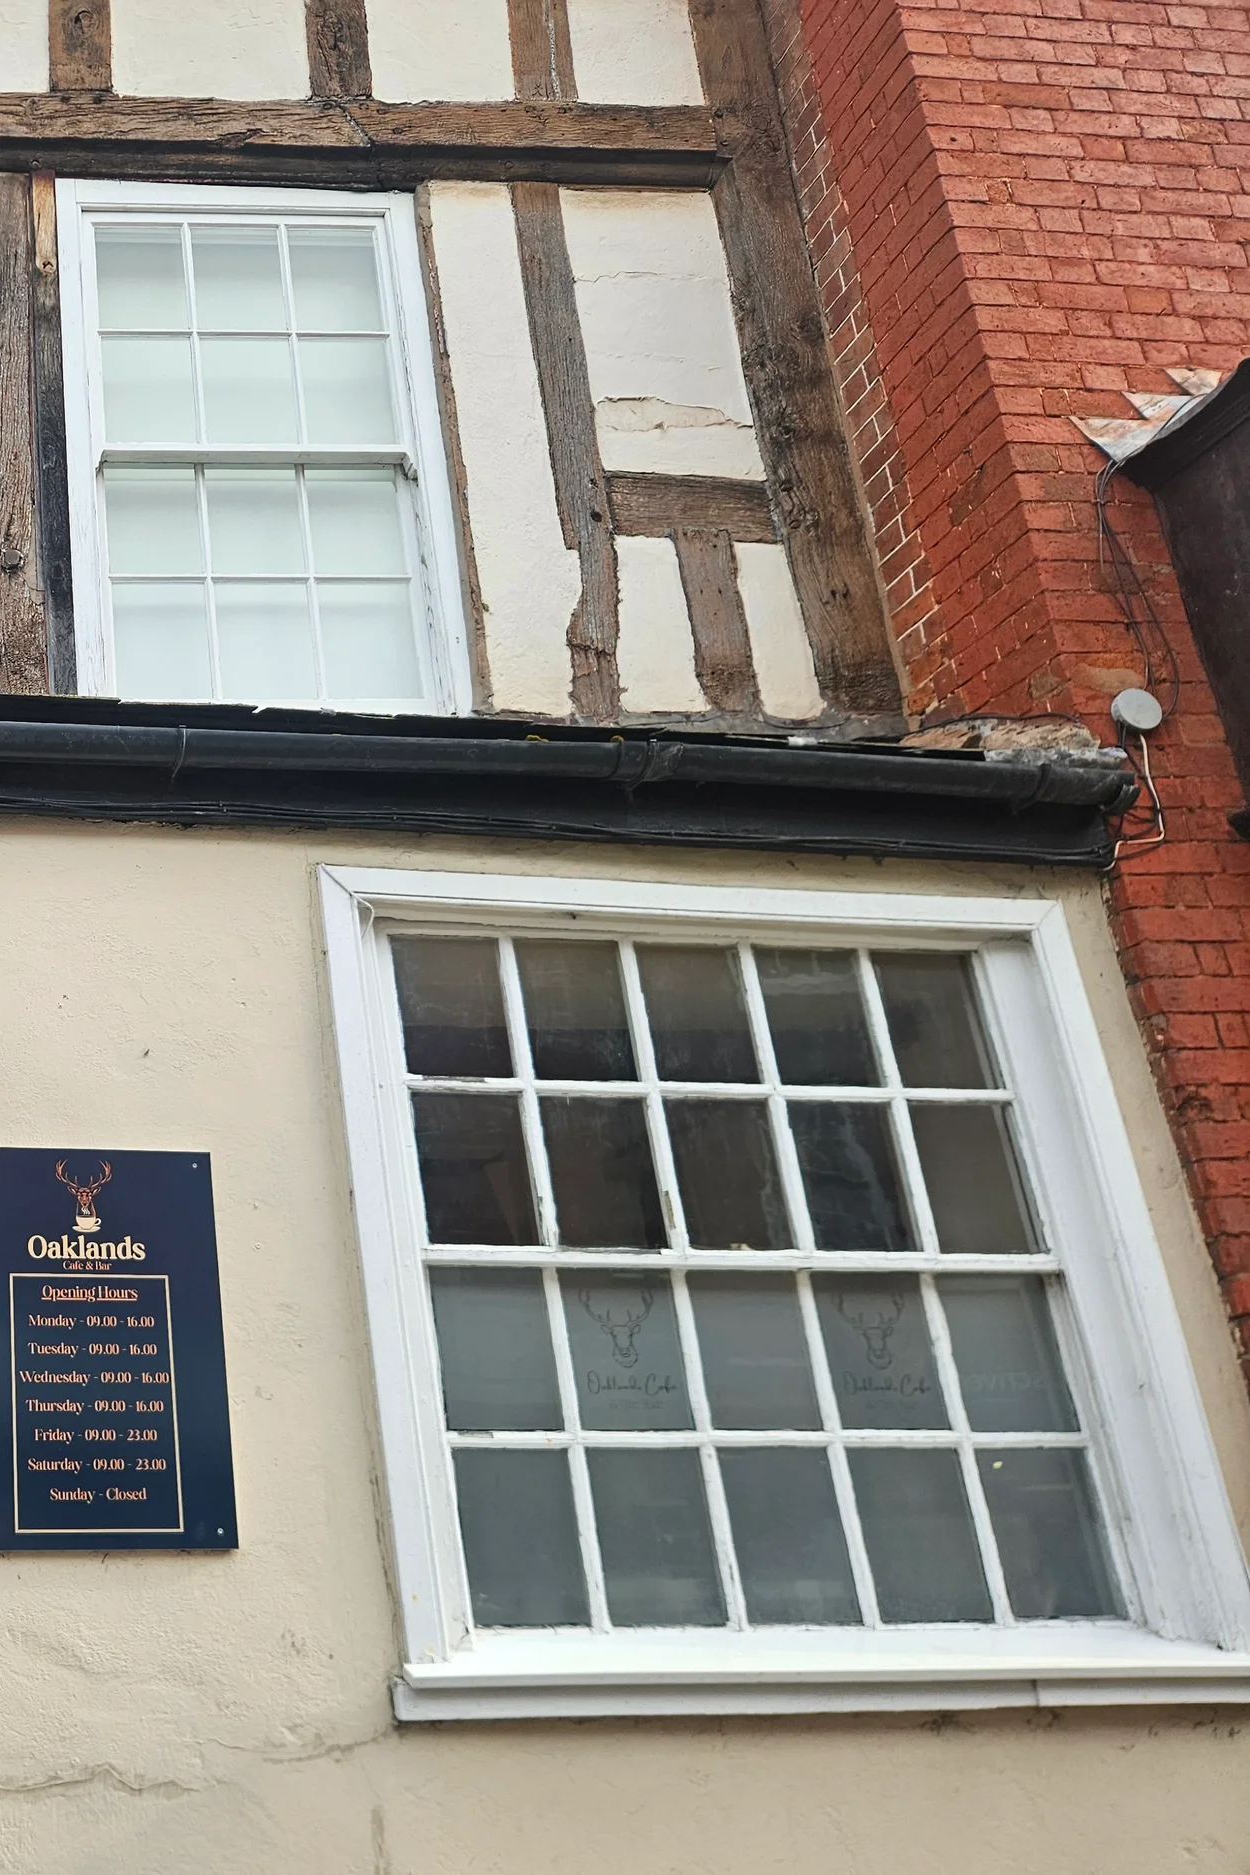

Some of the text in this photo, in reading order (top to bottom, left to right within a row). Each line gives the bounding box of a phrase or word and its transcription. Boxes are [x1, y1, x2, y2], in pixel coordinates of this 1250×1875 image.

[27, 1234, 146, 1261] Oaklands
[62, 1260, 113, 1271] Cafe & Bar
[41, 1284, 139, 1302] Opening Hours
[28, 1314, 77, 1330] Monday
[86, 1315, 118, 1327] 09.00
[126, 1316, 155, 1328] 16.00
[27, 1342, 79, 1358] Tuesday
[88, 1343, 120, 1355] 09.00
[129, 1344, 158, 1355] 16.00
[19, 1370, 91, 1387] Wednesday
[100, 1371, 132, 1384] 09.00
[141, 1371, 170, 1384] 16.00
[25, 1399, 85, 1416] Thursday
[94, 1400, 126, 1412] 09.00
[135, 1400, 164, 1412] 16.00
[34, 1428, 75, 1445] Friday
[84, 1429, 117, 1441] 09.00
[126, 1429, 158, 1441] 23.00
[27, 1457, 83, 1474] Saturday
[92, 1458, 125, 1470] 09.00
[135, 1458, 167, 1470] 23.00
[49, 1487, 96, 1504] Sunday
[105, 1487, 147, 1501] Closed
